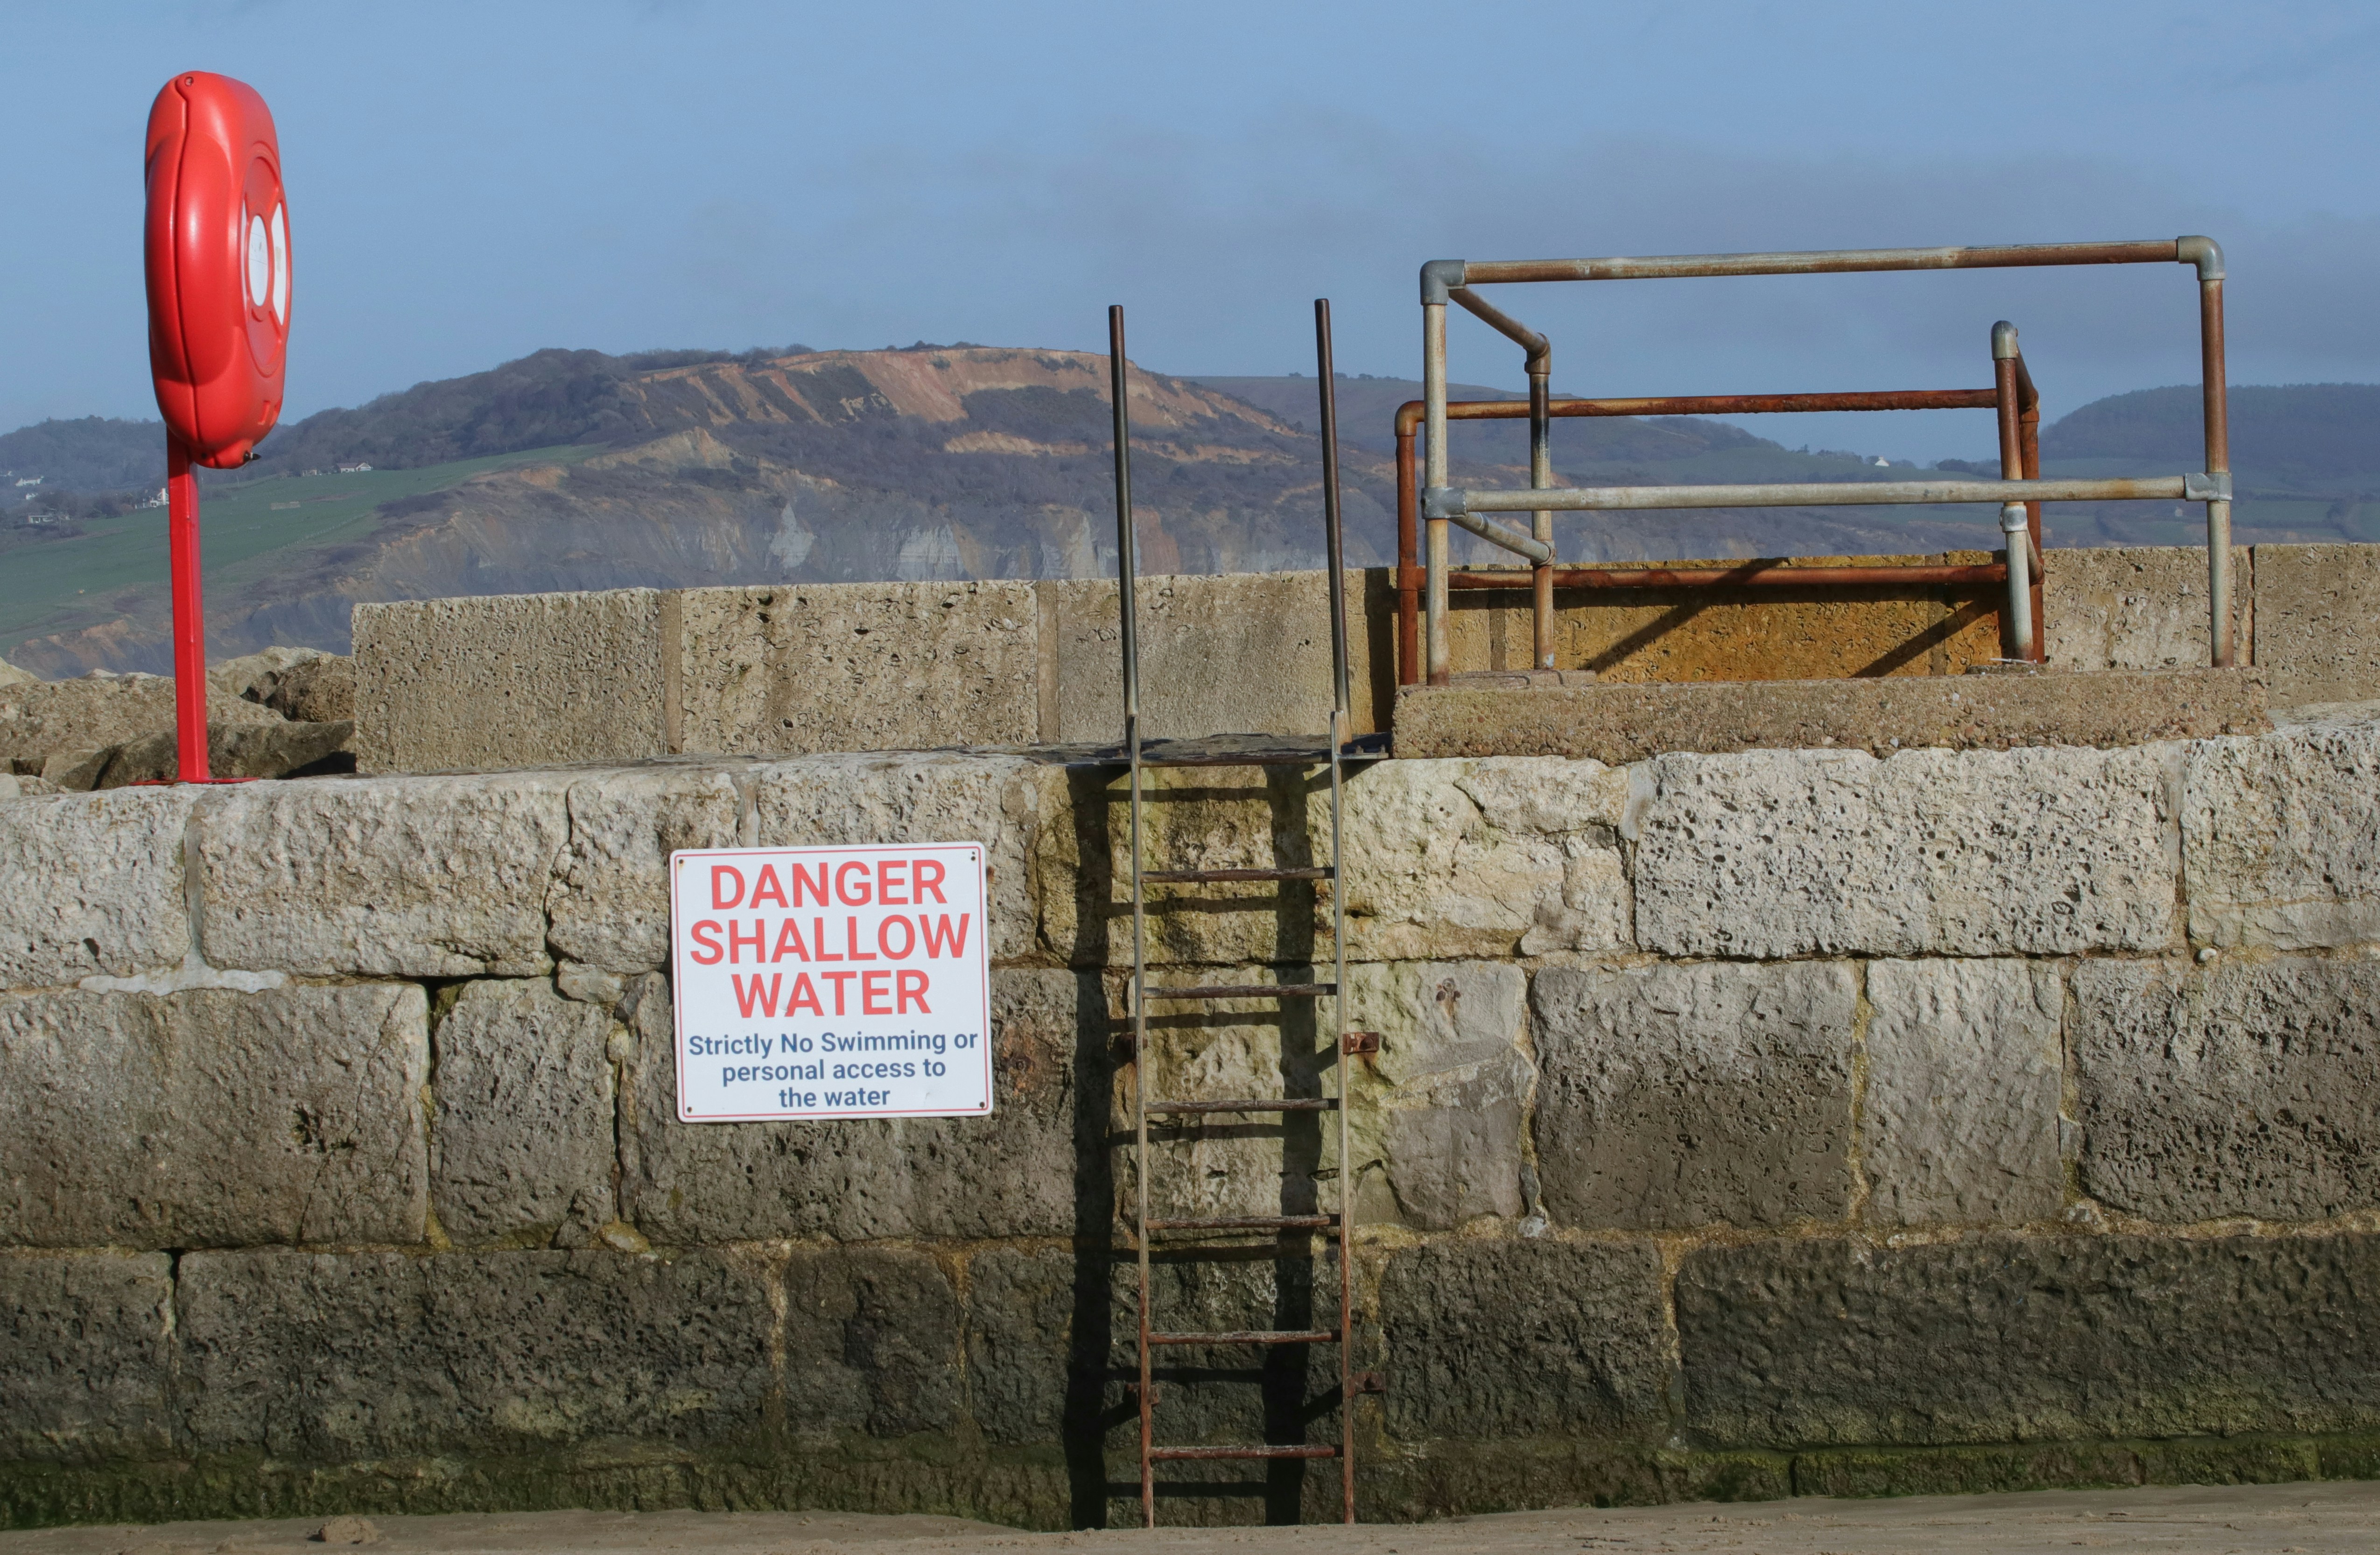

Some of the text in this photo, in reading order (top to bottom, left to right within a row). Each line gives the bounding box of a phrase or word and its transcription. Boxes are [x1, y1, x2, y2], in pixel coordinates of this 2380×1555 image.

[711, 860, 947, 910] DANGER
[690, 913, 970, 965] SHALLOW
[731, 969, 932, 1018] WATER
[689, 1030, 978, 1059] Strictly No Swimming or
[722, 1060, 946, 1087] personal access to
[779, 1087, 891, 1108] the water
